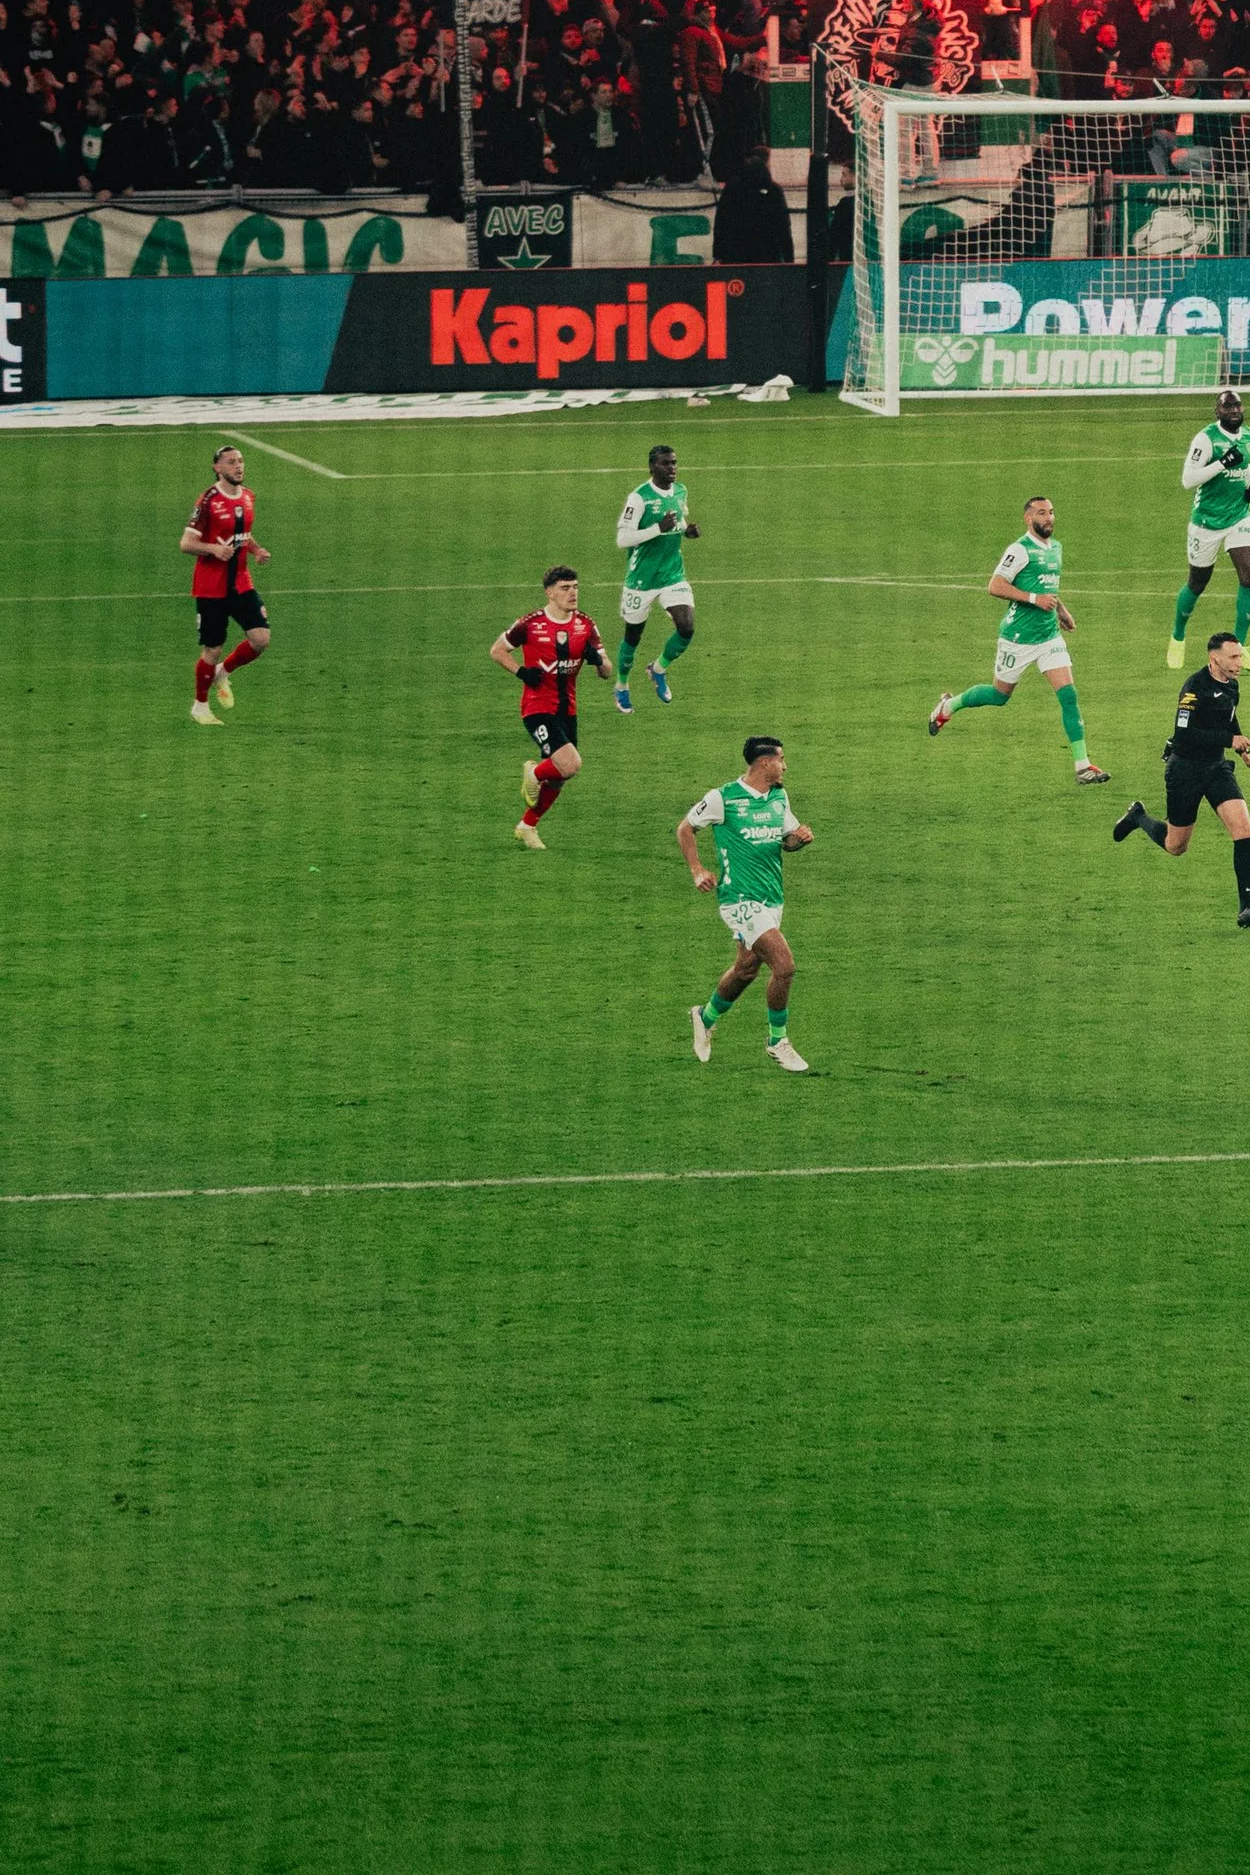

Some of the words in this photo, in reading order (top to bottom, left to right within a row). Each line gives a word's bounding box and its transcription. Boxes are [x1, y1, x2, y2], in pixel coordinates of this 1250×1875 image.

[484, 204, 565, 238] AVEC
[981, 337, 1178, 385] hummel
[625, 592, 642, 610] 39
[1001, 651, 1016, 669] 10
[534, 724, 549, 744] 19
